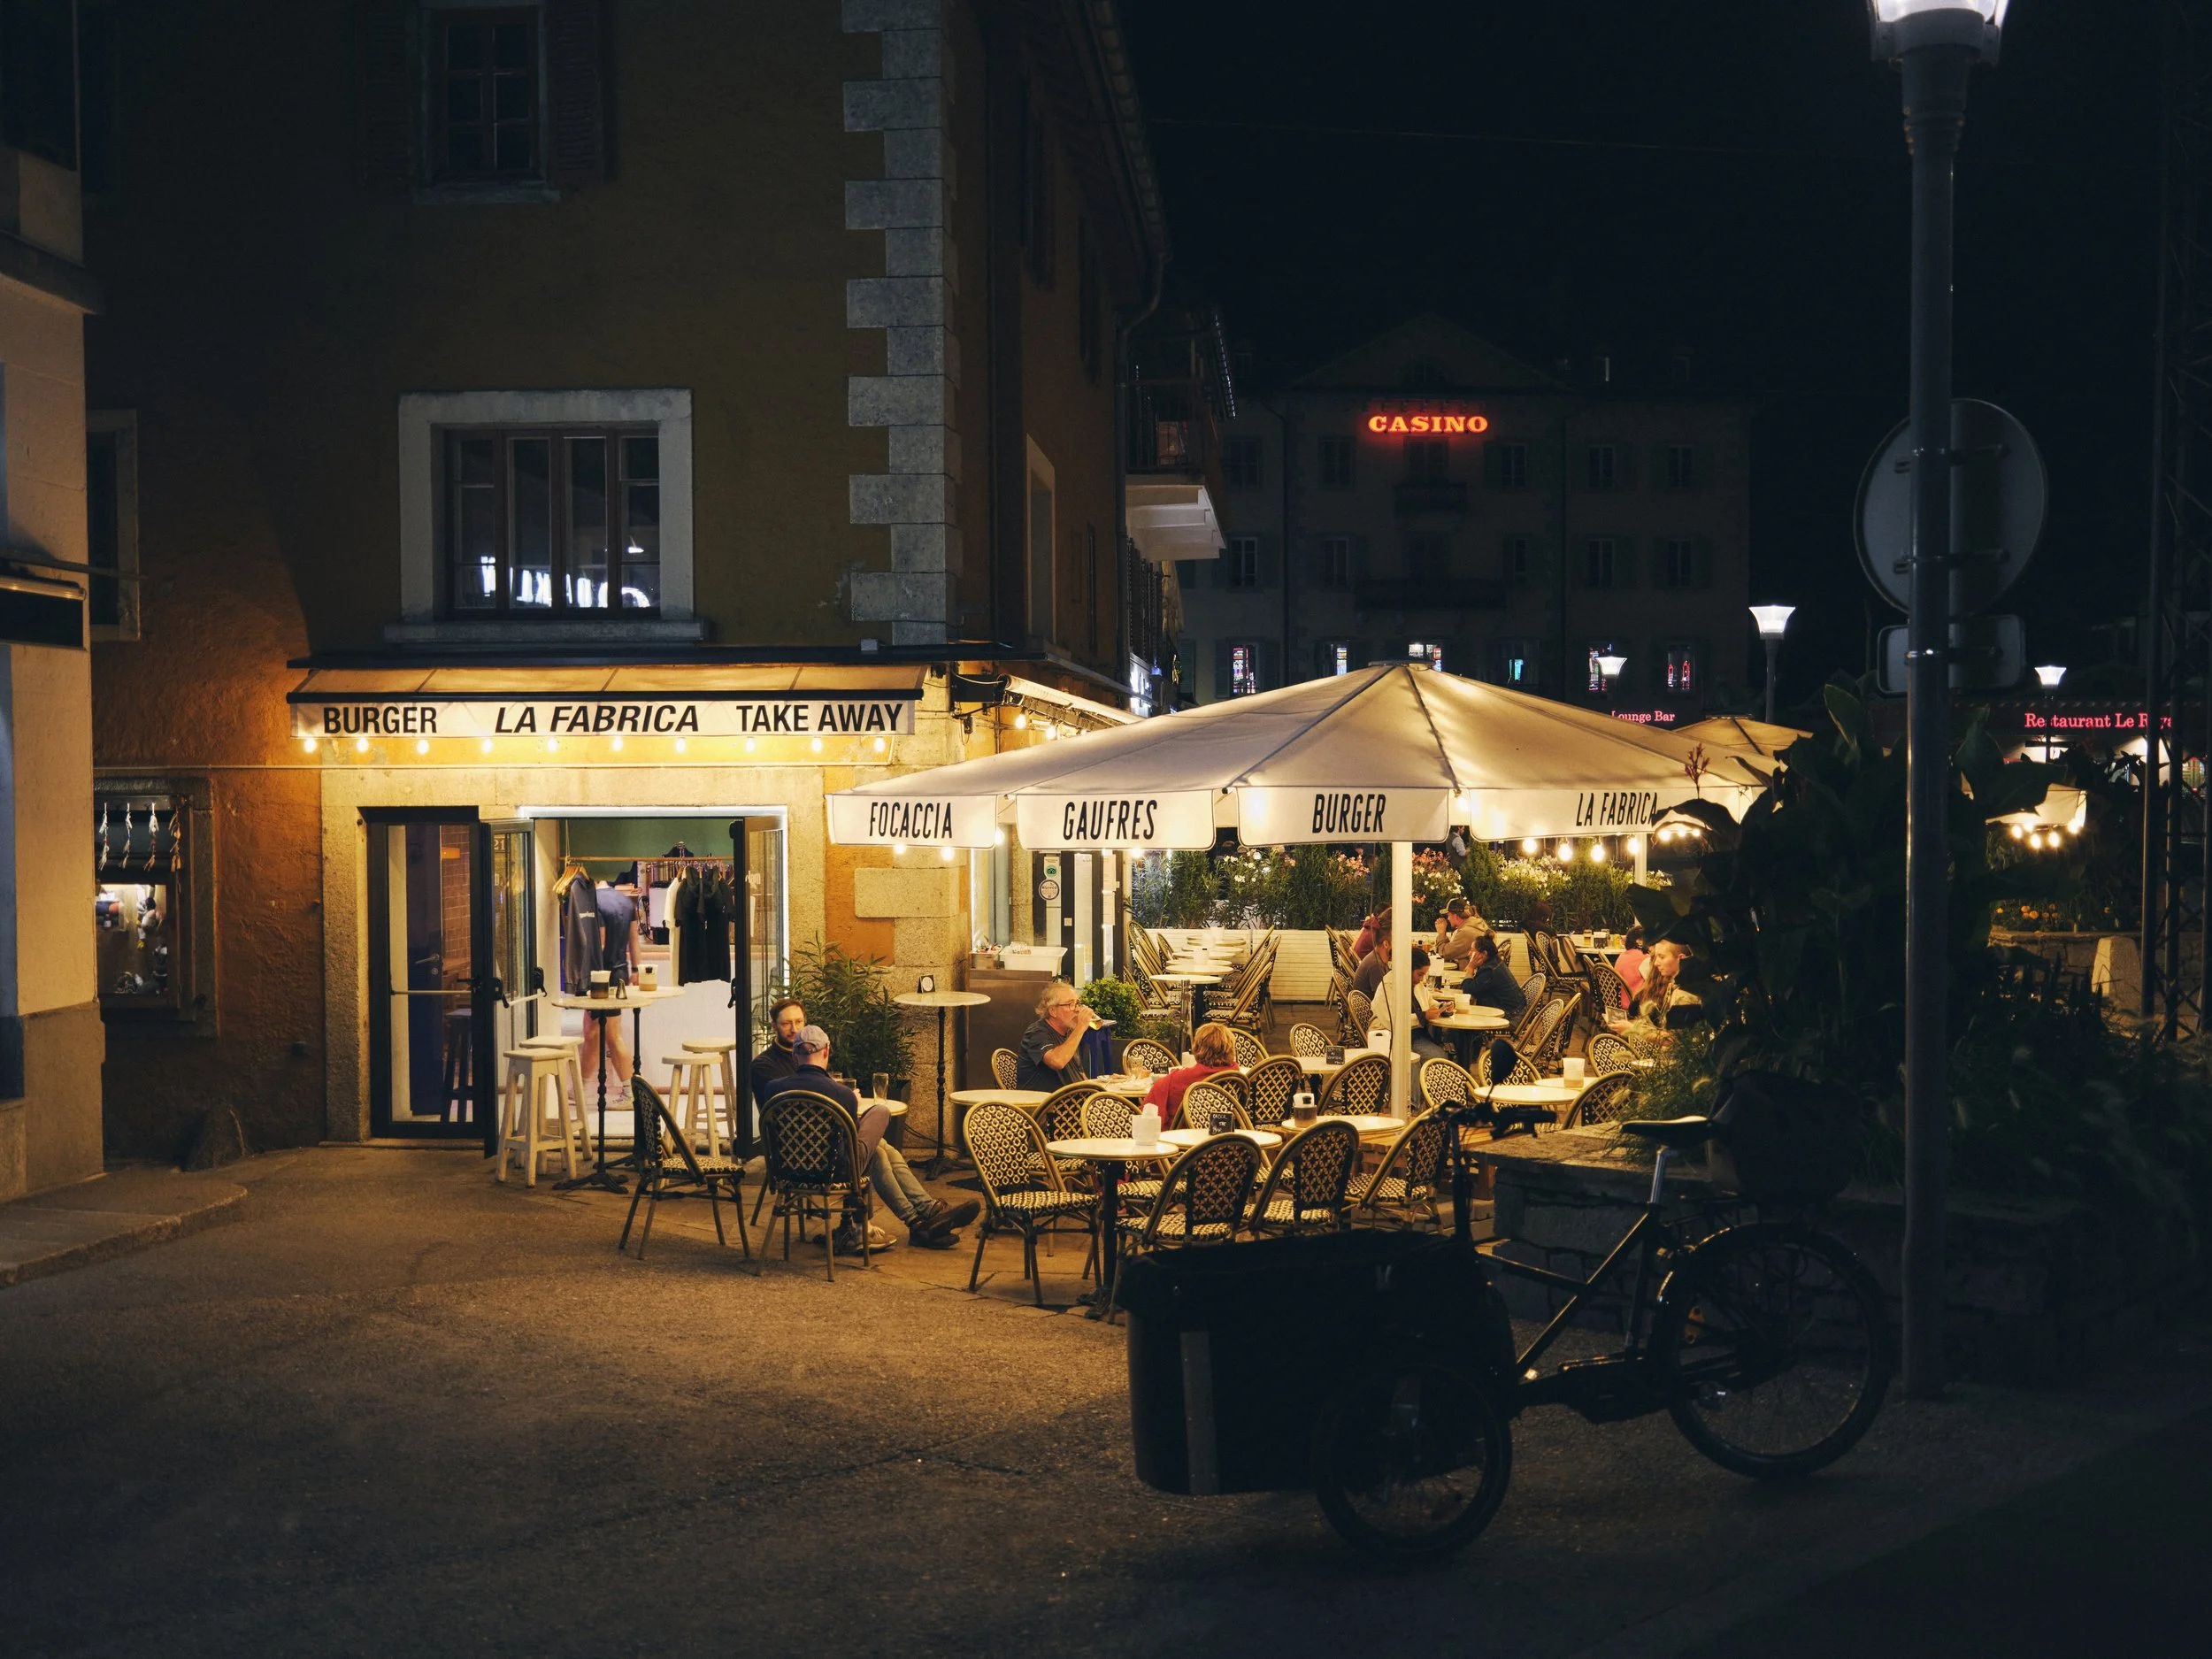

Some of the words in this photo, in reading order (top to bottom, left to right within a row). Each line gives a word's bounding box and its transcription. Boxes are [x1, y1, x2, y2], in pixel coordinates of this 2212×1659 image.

[1369, 415, 1488, 433] CASINO
[323, 706, 437, 734] BURGER
[495, 706, 537, 733] LA
[549, 704, 700, 733] FABRICA
[736, 704, 810, 733] TAKE
[817, 703, 903, 732] AWAY
[1654, 710, 1675, 722] Bar
[2024, 712, 2112, 728] Retaurant
[2115, 712, 2134, 728] Le
[870, 802, 953, 839] FOCACCIA
[1063, 800, 1157, 840] GAUFRES
[1312, 794, 1386, 833] BURGER
[1576, 793, 1594, 826] LA
[1600, 792, 1658, 826] FABRICA
